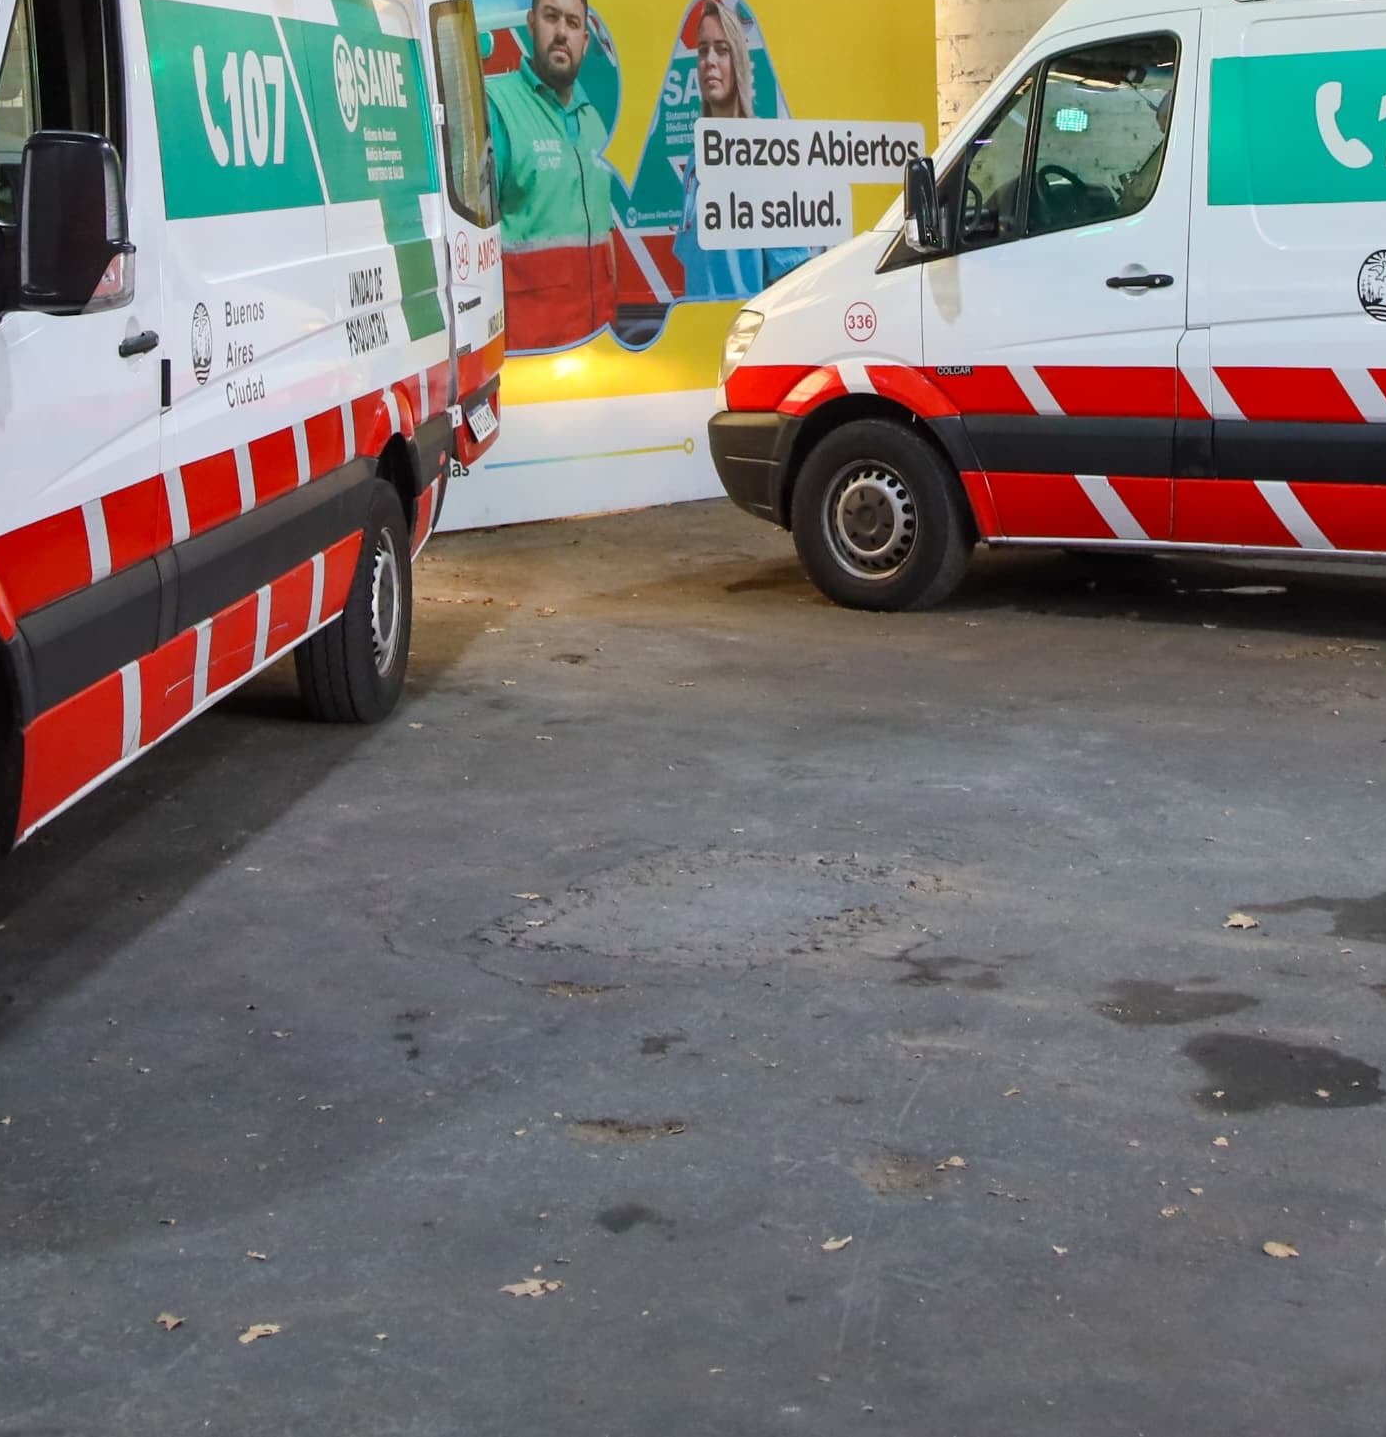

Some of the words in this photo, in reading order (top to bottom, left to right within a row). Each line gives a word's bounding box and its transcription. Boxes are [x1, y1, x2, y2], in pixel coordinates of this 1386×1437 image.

[354, 45, 408, 109] SAME
[222, 49, 286, 168] 107
[702, 129, 801, 167] Brazos
[807, 129, 919, 167] Abiertos
[704, 200, 722, 231] a
[729, 191, 754, 230] la
[761, 190, 842, 229] salud.
[456, 243, 469, 269] 342
[348, 268, 374, 308] UNIDAD
[373, 266, 383, 302] DE
[224, 300, 265, 327] Buenos
[847, 314, 874, 330] 336
[345, 311, 390, 356] PSIQUIATRIA
[226, 342, 254, 368] Aires
[225, 375, 266, 408] Ciudad
